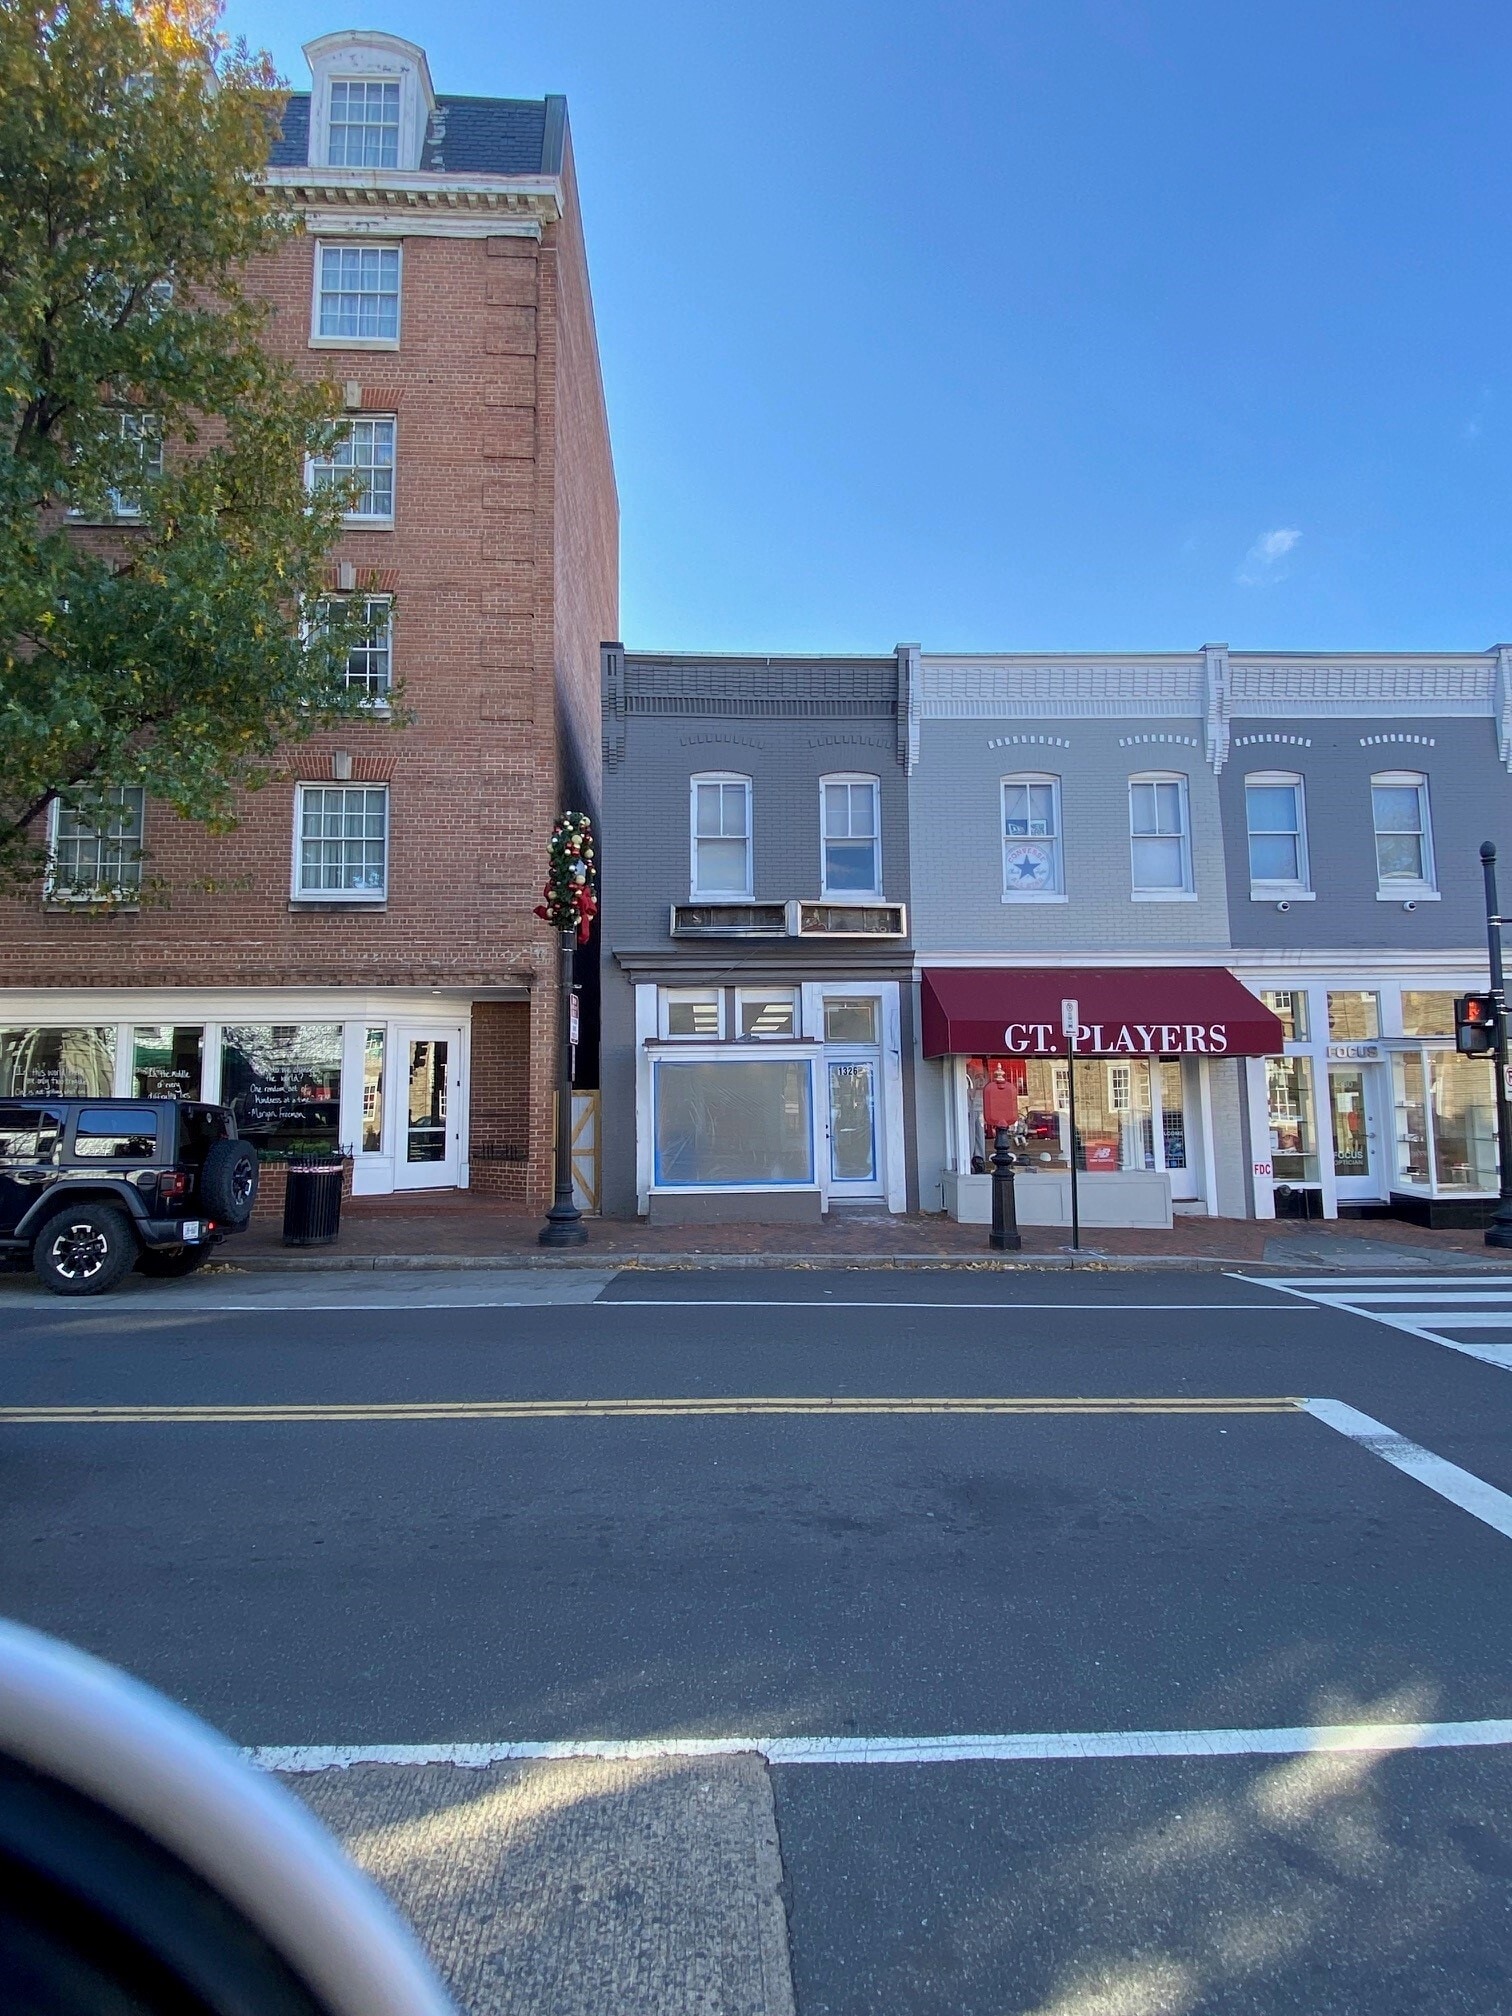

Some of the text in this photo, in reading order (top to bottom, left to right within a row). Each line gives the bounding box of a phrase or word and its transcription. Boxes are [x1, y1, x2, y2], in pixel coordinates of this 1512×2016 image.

[1008, 847, 1046, 863] CONVERSE
[1004, 1024, 1228, 1053] GT. PLAYERS
[1327, 1046, 1378, 1059] FOCUS
[838, 1067, 858, 1076] 1326
[250, 1083, 262, 1093] One
[1334, 1150, 1364, 1159] FOCUS
[1254, 1164, 1271, 1175] FDC
